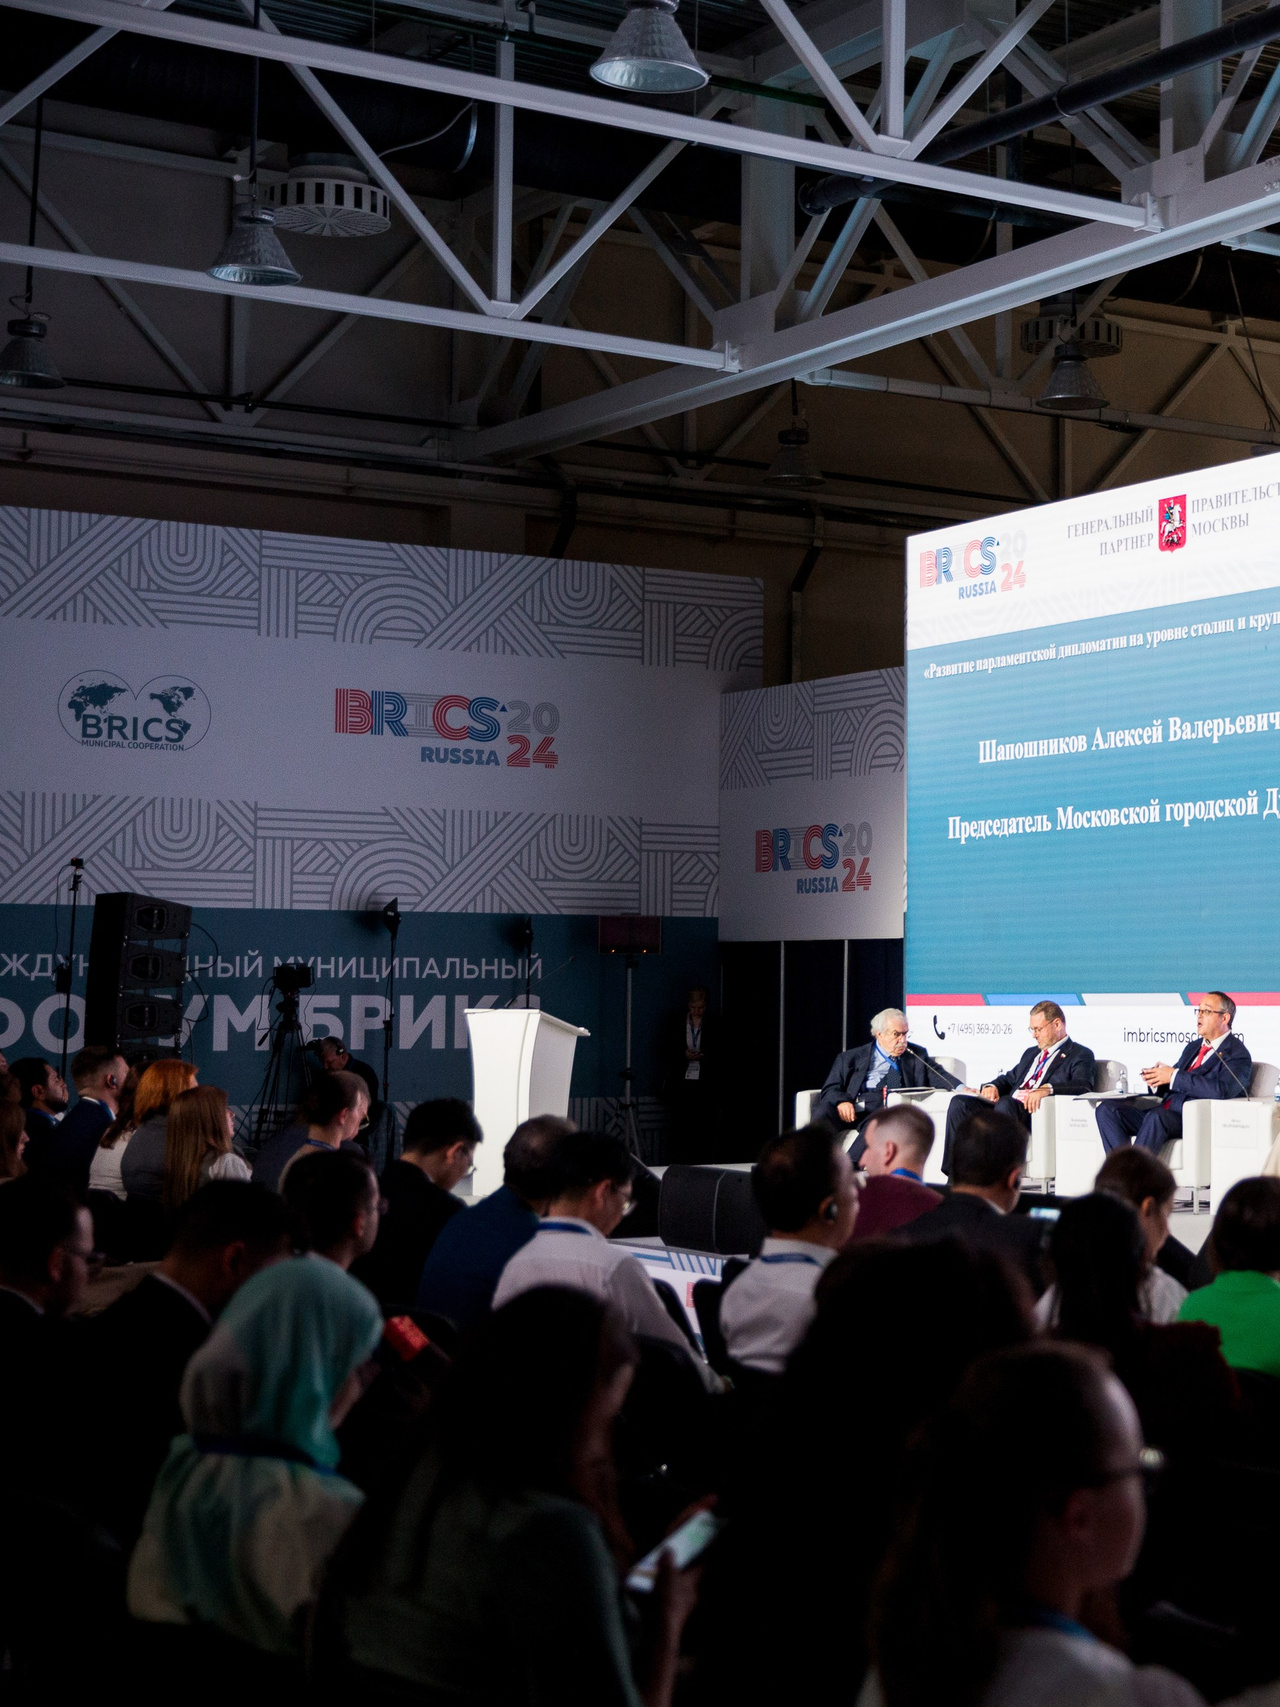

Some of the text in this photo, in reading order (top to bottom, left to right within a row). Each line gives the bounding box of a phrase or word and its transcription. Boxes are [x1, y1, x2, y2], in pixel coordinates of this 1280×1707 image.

[1066, 506, 1154, 539] ГЕНЕРАЛЬНЫЙ
[1191, 512, 1250, 538] МОСКВЫ
[919, 528, 1028, 589] BRICS 20
[1099, 533, 1154, 556] ПАРТНЕР
[958, 560, 1027, 600] RUSSIA 24
[923, 659, 976, 680] «Развитие
[975, 644, 1057, 675] парламентской
[1057, 634, 1128, 660] дипломатии
[1129, 635, 1144, 646] на
[1145, 628, 1189, 649] уровне
[1190, 617, 1235, 638] столиц
[1237, 618, 1246, 630] и
[81, 714, 185, 744] BRICS
[335, 688, 560, 743] BRICS 20
[81, 740, 185, 752] MUNICIPAL COOPERATION
[420, 734, 559, 769] RUSSIA 24
[978, 711, 1280, 764] Шапошников Алексей Валерьевич
[947, 810, 1052, 845] Председатель
[1056, 799, 1161, 831] Московской
[1165, 789, 1259, 828] городской
[755, 821, 873, 873] BRICS 20
[796, 857, 872, 894] RUSSIA 24
[301, 993, 541, 1051] БРИК
[957, 1023, 976, 1036] (495)
[976, 1023, 1013, 1035] 369-20-26
